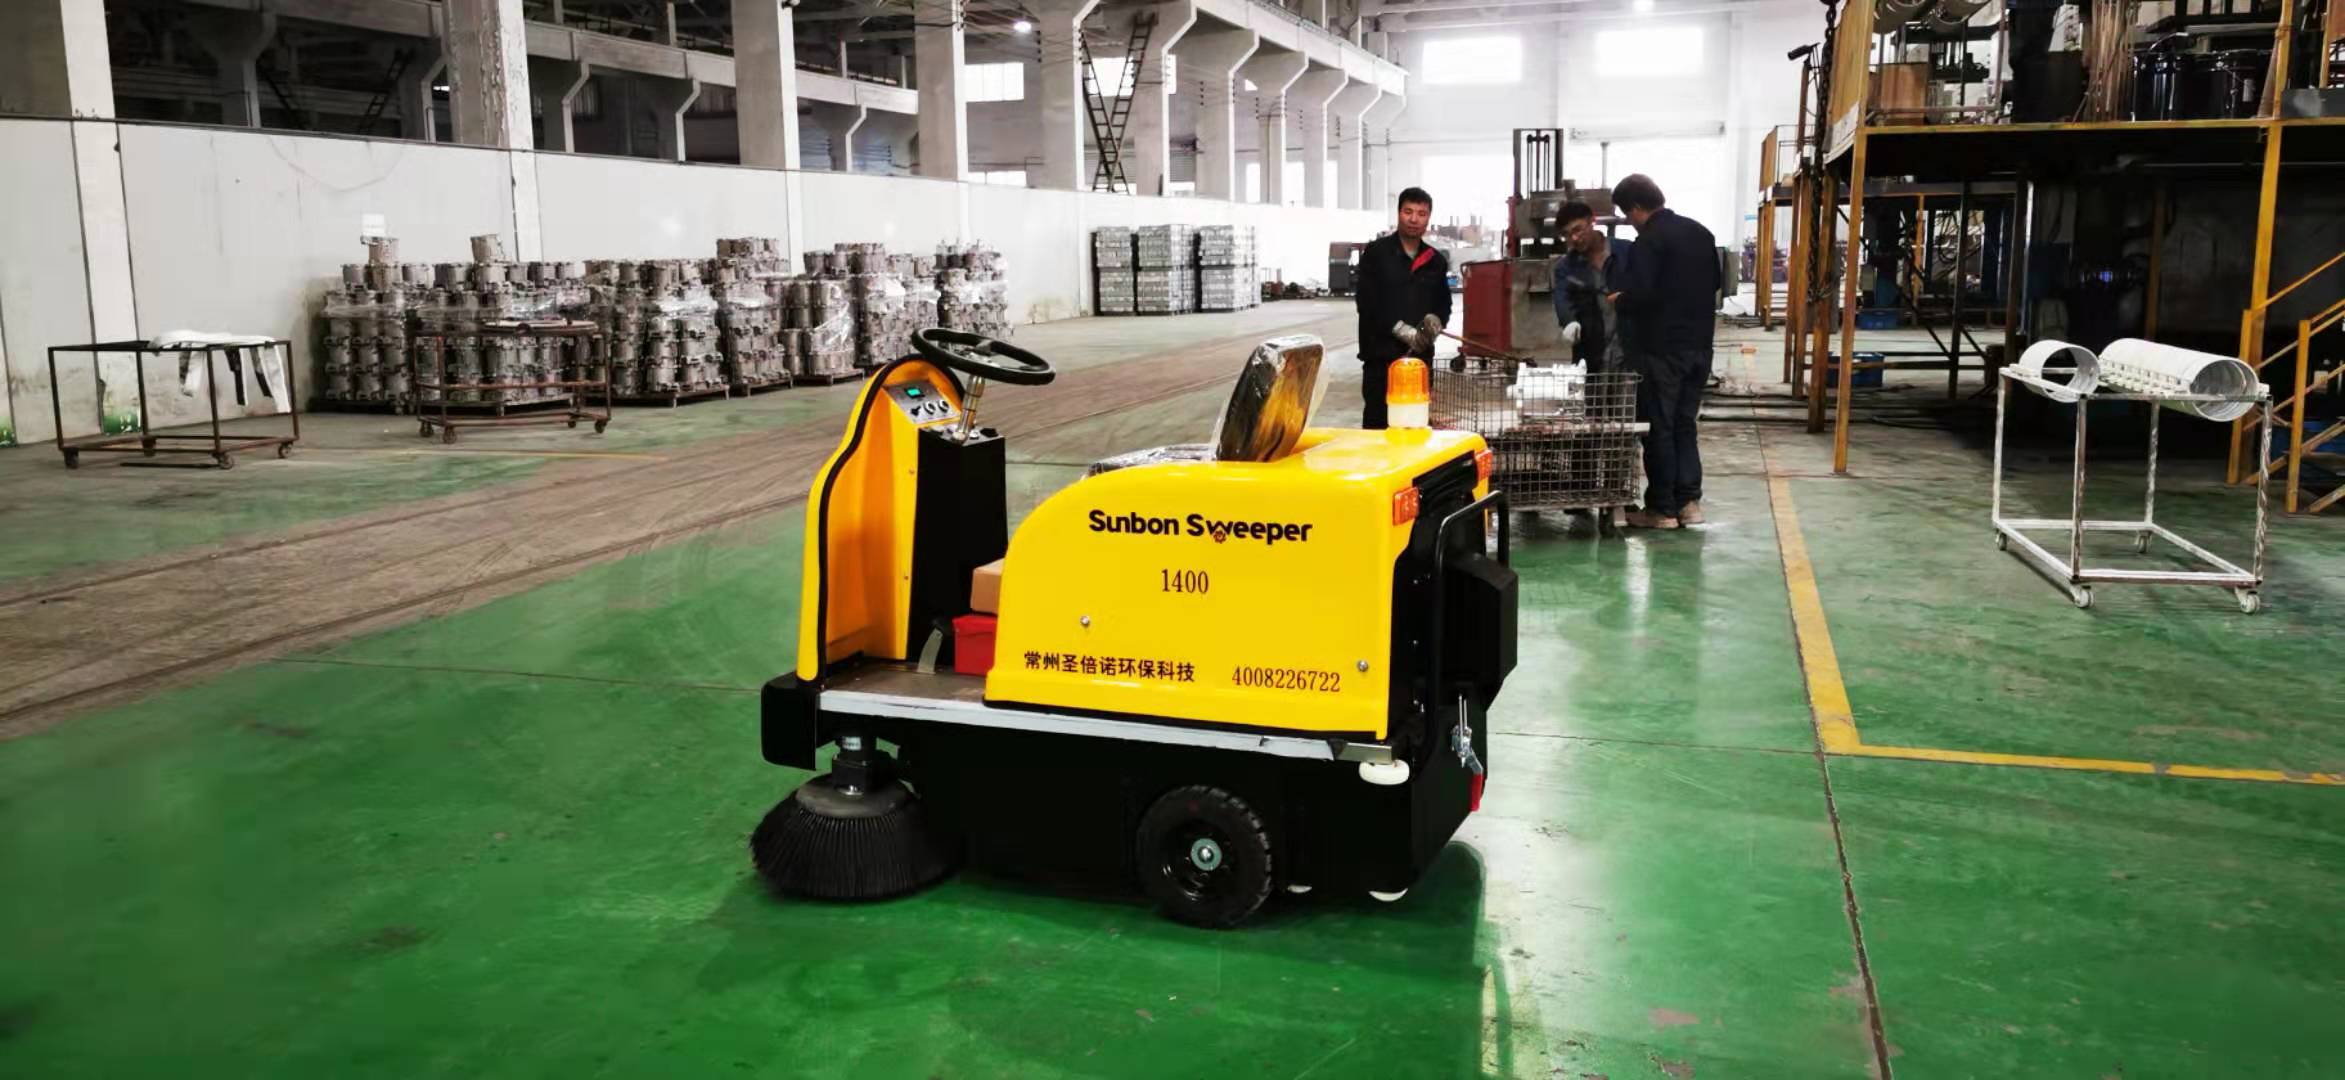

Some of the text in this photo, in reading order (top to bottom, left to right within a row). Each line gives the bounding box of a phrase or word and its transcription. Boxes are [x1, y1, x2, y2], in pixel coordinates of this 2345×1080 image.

[1088, 509, 1313, 545] Sunbon Sweeper
[1161, 568, 1209, 594] 1400
[1023, 651, 1195, 683] 常州圣倍诺环保科技
[1231, 666, 1341, 692] 4008226722
